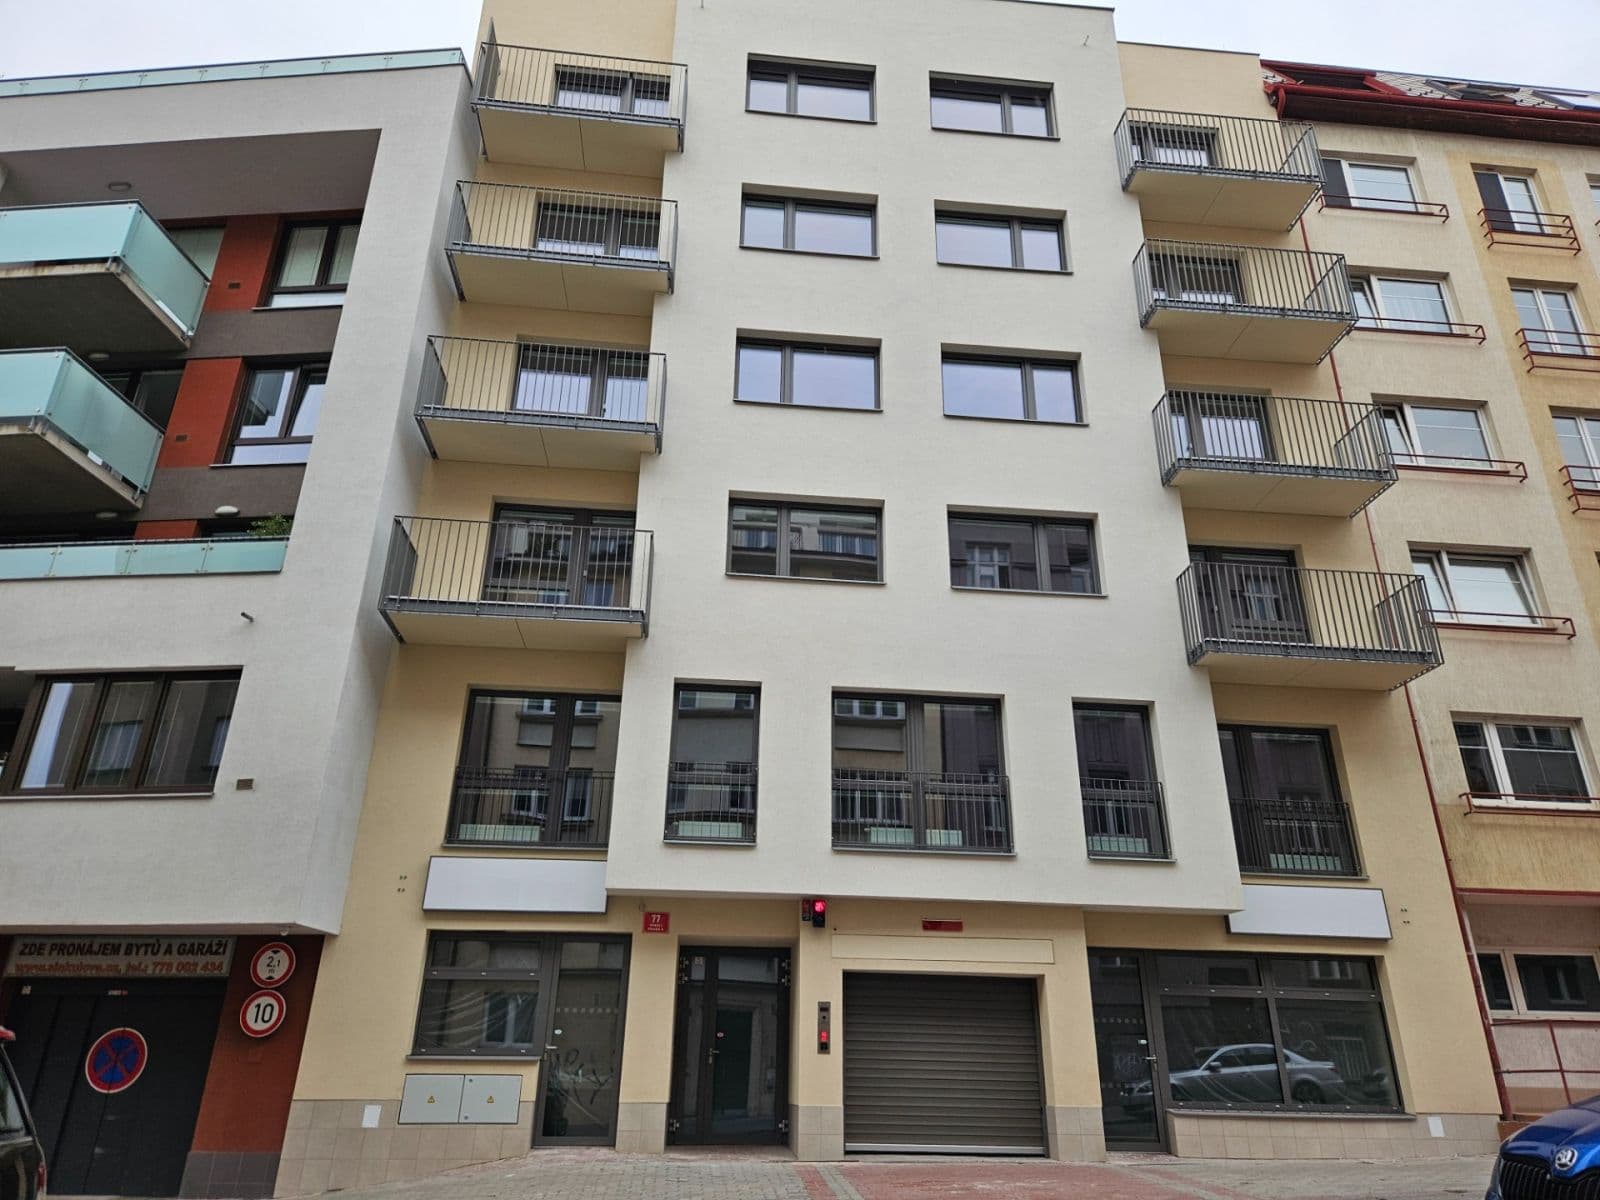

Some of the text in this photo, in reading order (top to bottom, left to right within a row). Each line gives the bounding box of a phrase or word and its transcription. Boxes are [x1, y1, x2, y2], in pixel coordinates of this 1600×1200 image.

[651, 914, 661, 923] 77
[19, 943, 46, 956] ZDE
[124, 938, 161, 956] BYTŮ
[163, 943, 173, 956] A
[176, 939, 228, 956] GARÁŽÍ
[254, 1003, 275, 1024] 10
